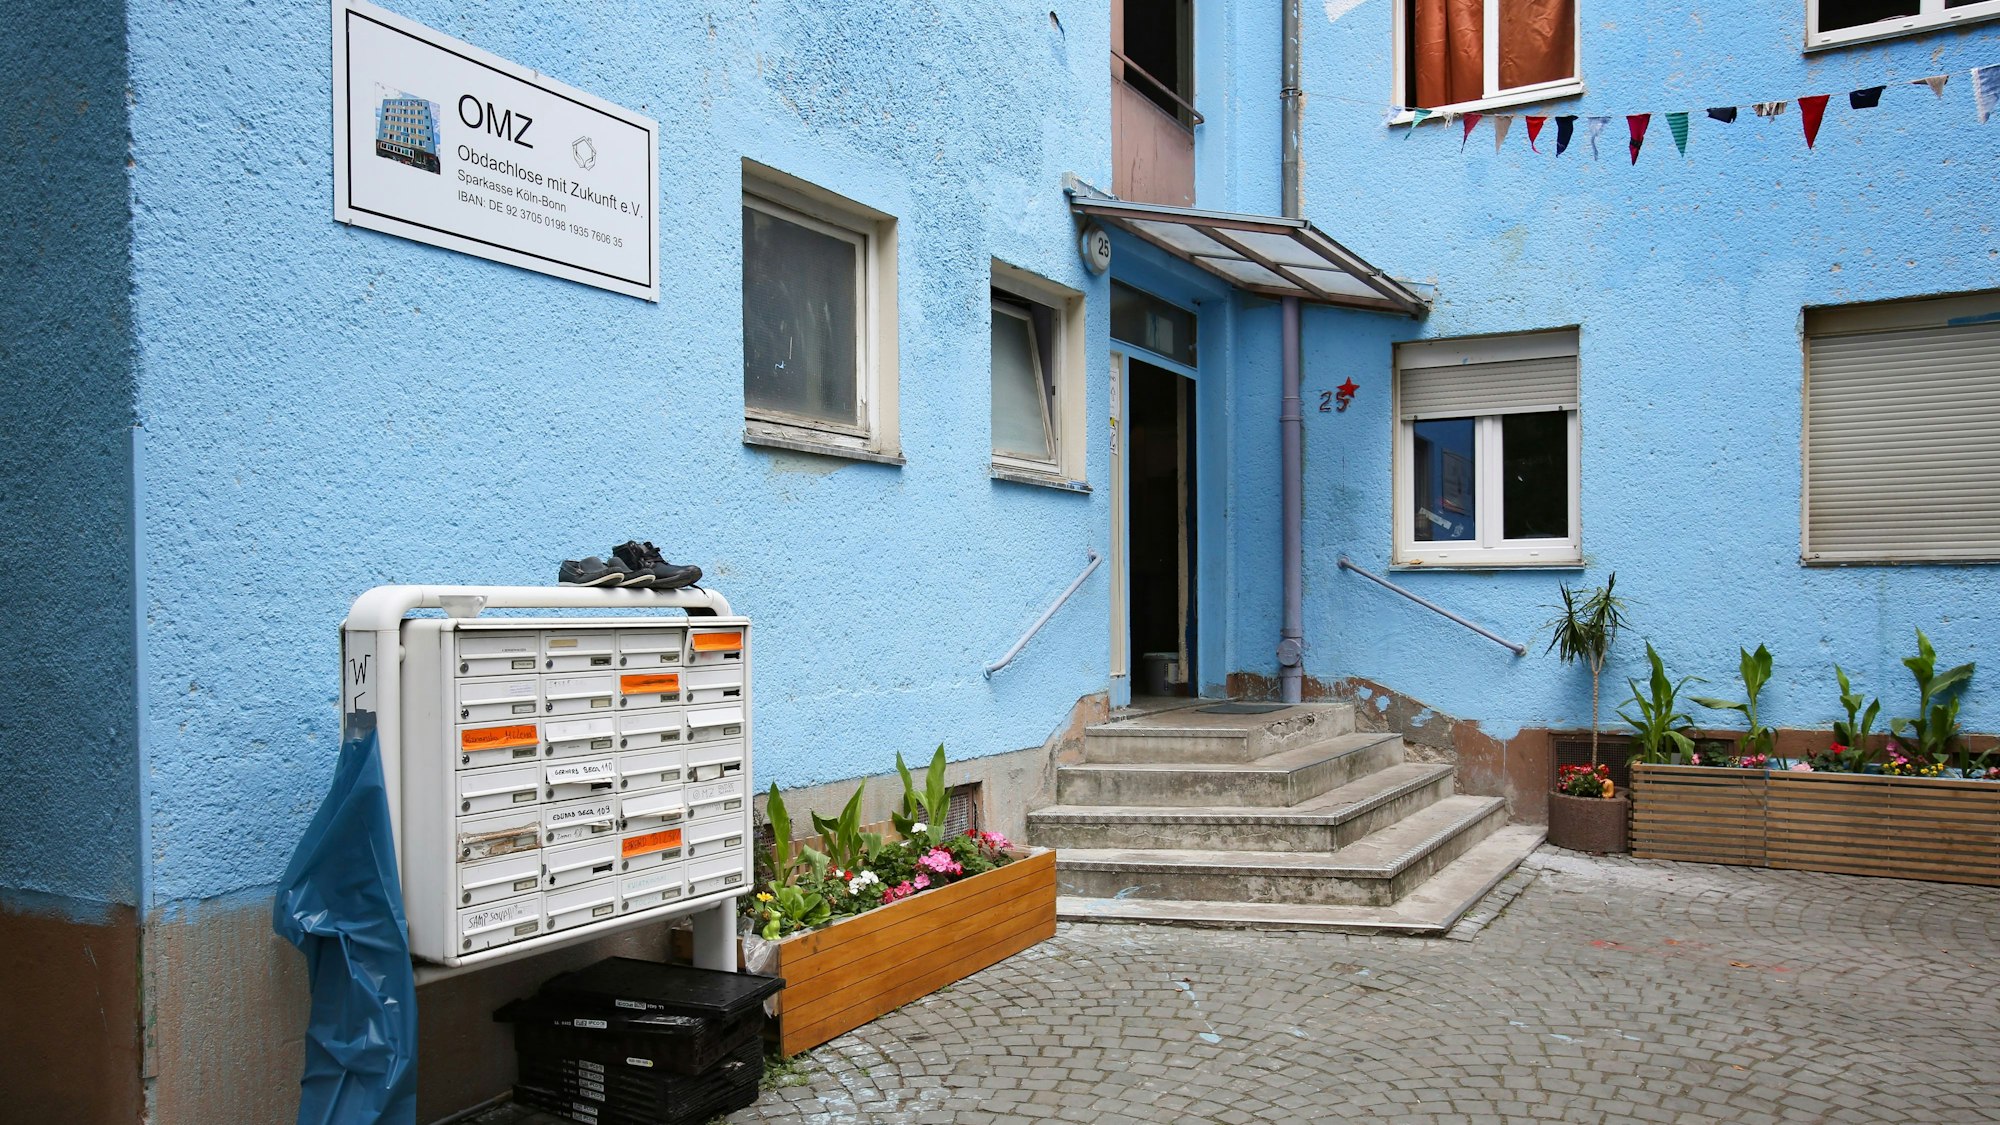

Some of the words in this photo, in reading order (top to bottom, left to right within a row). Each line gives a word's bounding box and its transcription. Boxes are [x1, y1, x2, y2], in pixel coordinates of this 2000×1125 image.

[458, 94, 534, 149] OMZ
[457, 144, 543, 186] Obdachlose
[547, 176, 567, 194] mit
[570, 181, 617, 210] Zukunft
[620, 201, 643, 218] e.V.
[457, 169, 513, 196] Sparkasse
[516, 186, 567, 213] Köln-Bonn
[458, 189, 486, 208] IBAN:
[489, 199, 503, 213] DE
[506, 204, 518, 217] 92
[520, 208, 543, 225] 3705
[544, 216, 566, 232] 0198
[569, 223, 589, 238] 1935
[591, 230, 611, 245] 7606
[612, 236, 623, 248] 35
[1098, 237, 1109, 258] 25
[1319, 391, 1350, 413] 25
